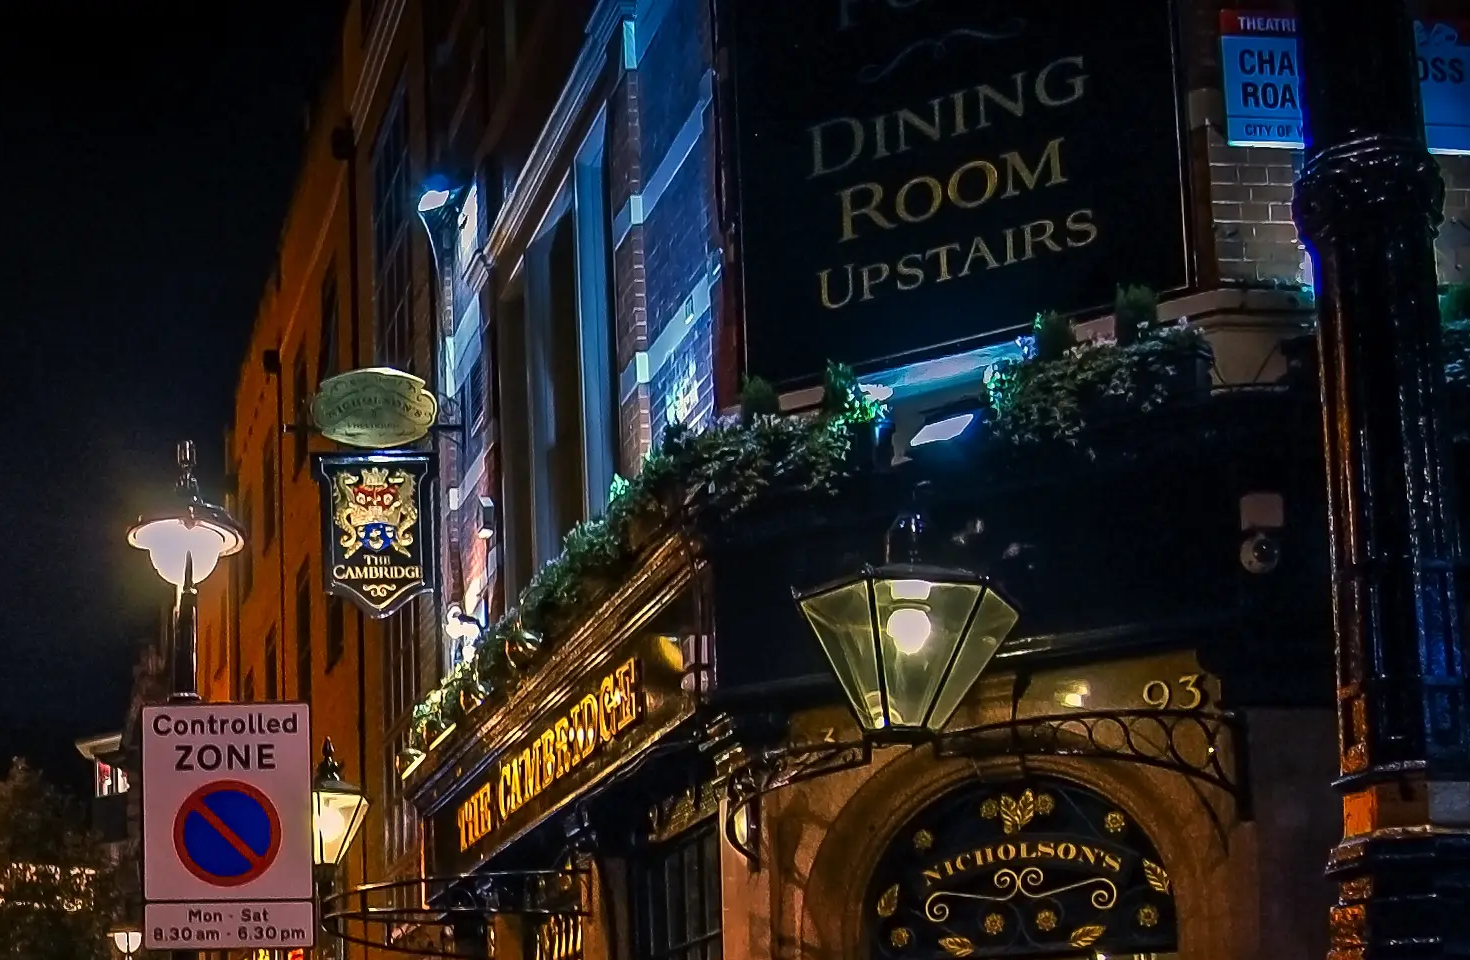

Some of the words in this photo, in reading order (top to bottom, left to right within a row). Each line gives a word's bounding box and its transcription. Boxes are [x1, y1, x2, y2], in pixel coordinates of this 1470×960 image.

[807, 56, 1090, 180] DINING
[1244, 123, 1273, 136] CITY
[1277, 125, 1292, 137] OF
[835, 136, 1068, 243] ROOM
[816, 209, 1098, 309] UPSTAIRS
[363, 553, 391, 566] THE
[1142, 675, 1201, 710] 93
[153, 713, 298, 736] Controlled
[175, 744, 276, 771] ZONE
[458, 782, 492, 852] THE
[498, 656, 637, 822] CAMBRIDGE
[922, 841, 1121, 885] NICHOLSON'S
[188, 908, 222, 922] Mon
[241, 907, 269, 922] Sat
[153, 926, 192, 941] 8.30
[196, 929, 220, 941] am
[238, 926, 276, 940] 6.30
[281, 929, 305, 943] pm
